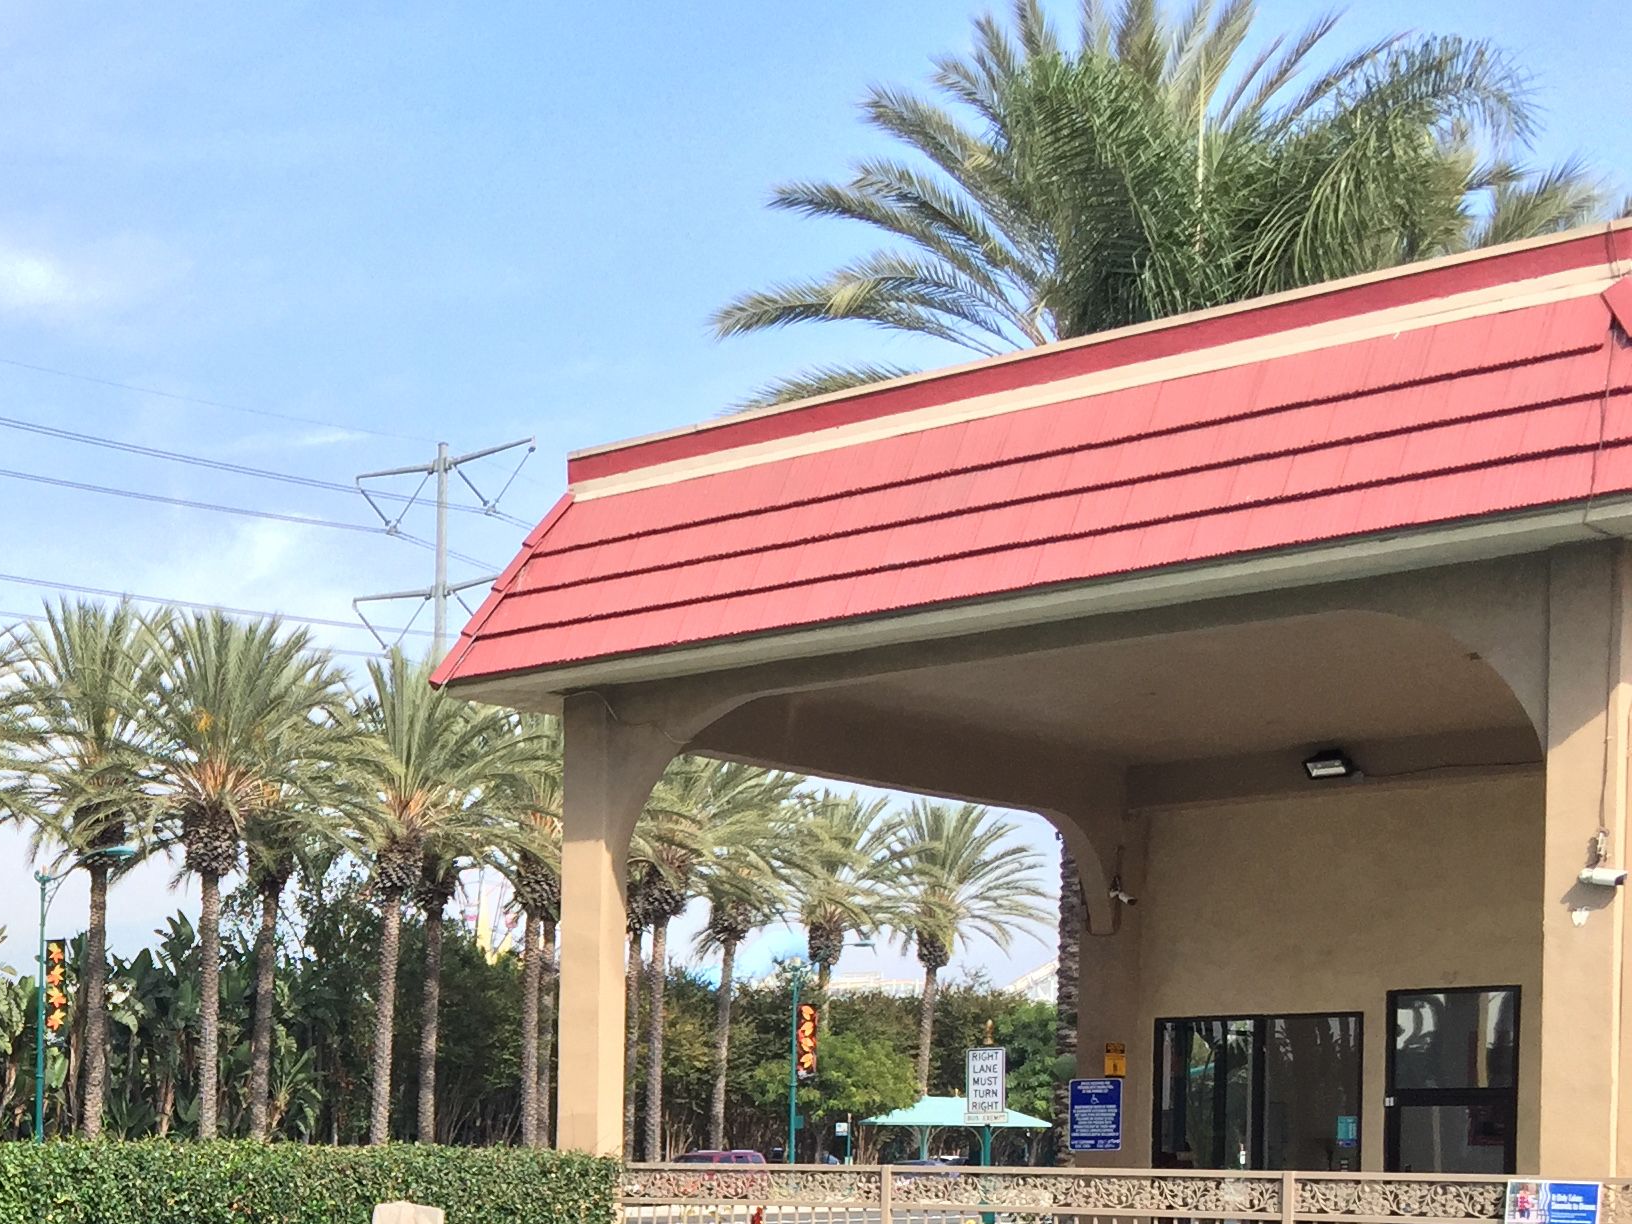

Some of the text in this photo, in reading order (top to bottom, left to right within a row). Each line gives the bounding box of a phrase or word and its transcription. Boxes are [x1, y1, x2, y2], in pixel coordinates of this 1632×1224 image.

[972, 1052, 999, 1061] RIGHT
[973, 1064, 998, 1073] LANE
[973, 1077, 998, 1086] MUST
[973, 1089, 998, 1098] TURN
[972, 1102, 999, 1110] RIGHT
